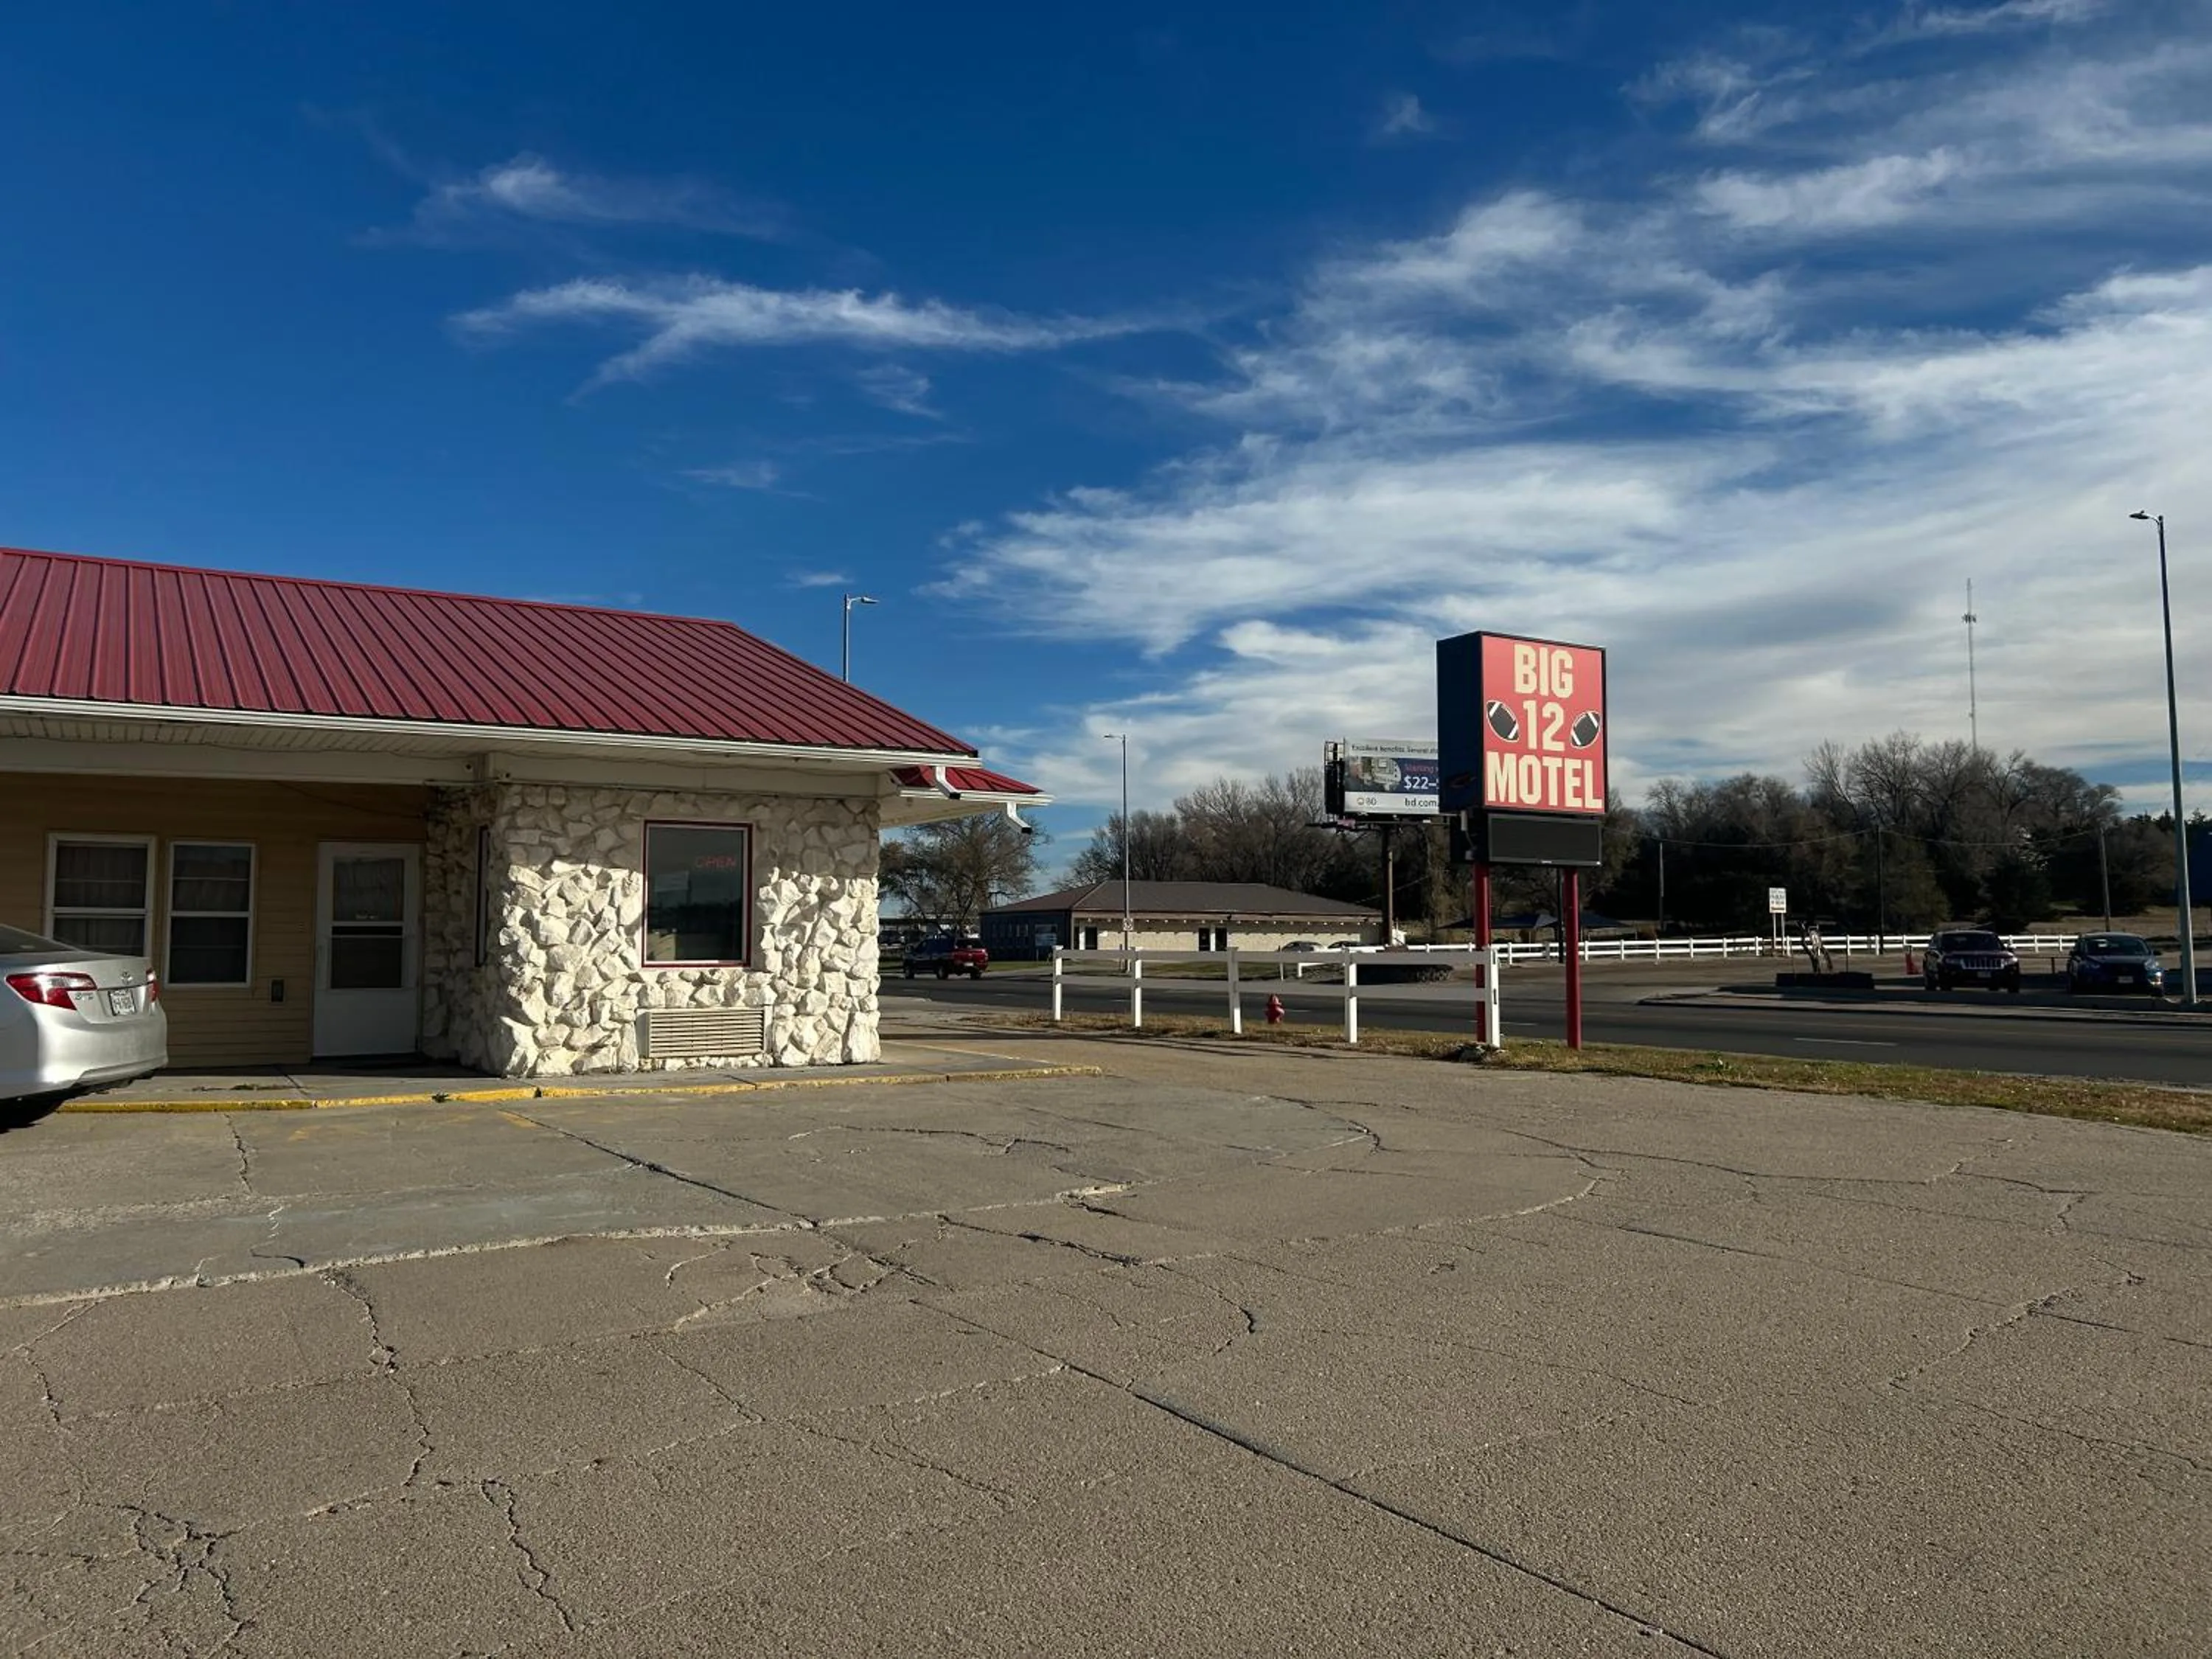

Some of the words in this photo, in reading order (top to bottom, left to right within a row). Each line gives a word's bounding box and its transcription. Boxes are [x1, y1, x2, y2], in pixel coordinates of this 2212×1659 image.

[1514, 643, 1573, 698] BIG
[1523, 700, 1565, 751] 12
[1486, 751, 1602, 809] MOTEL
